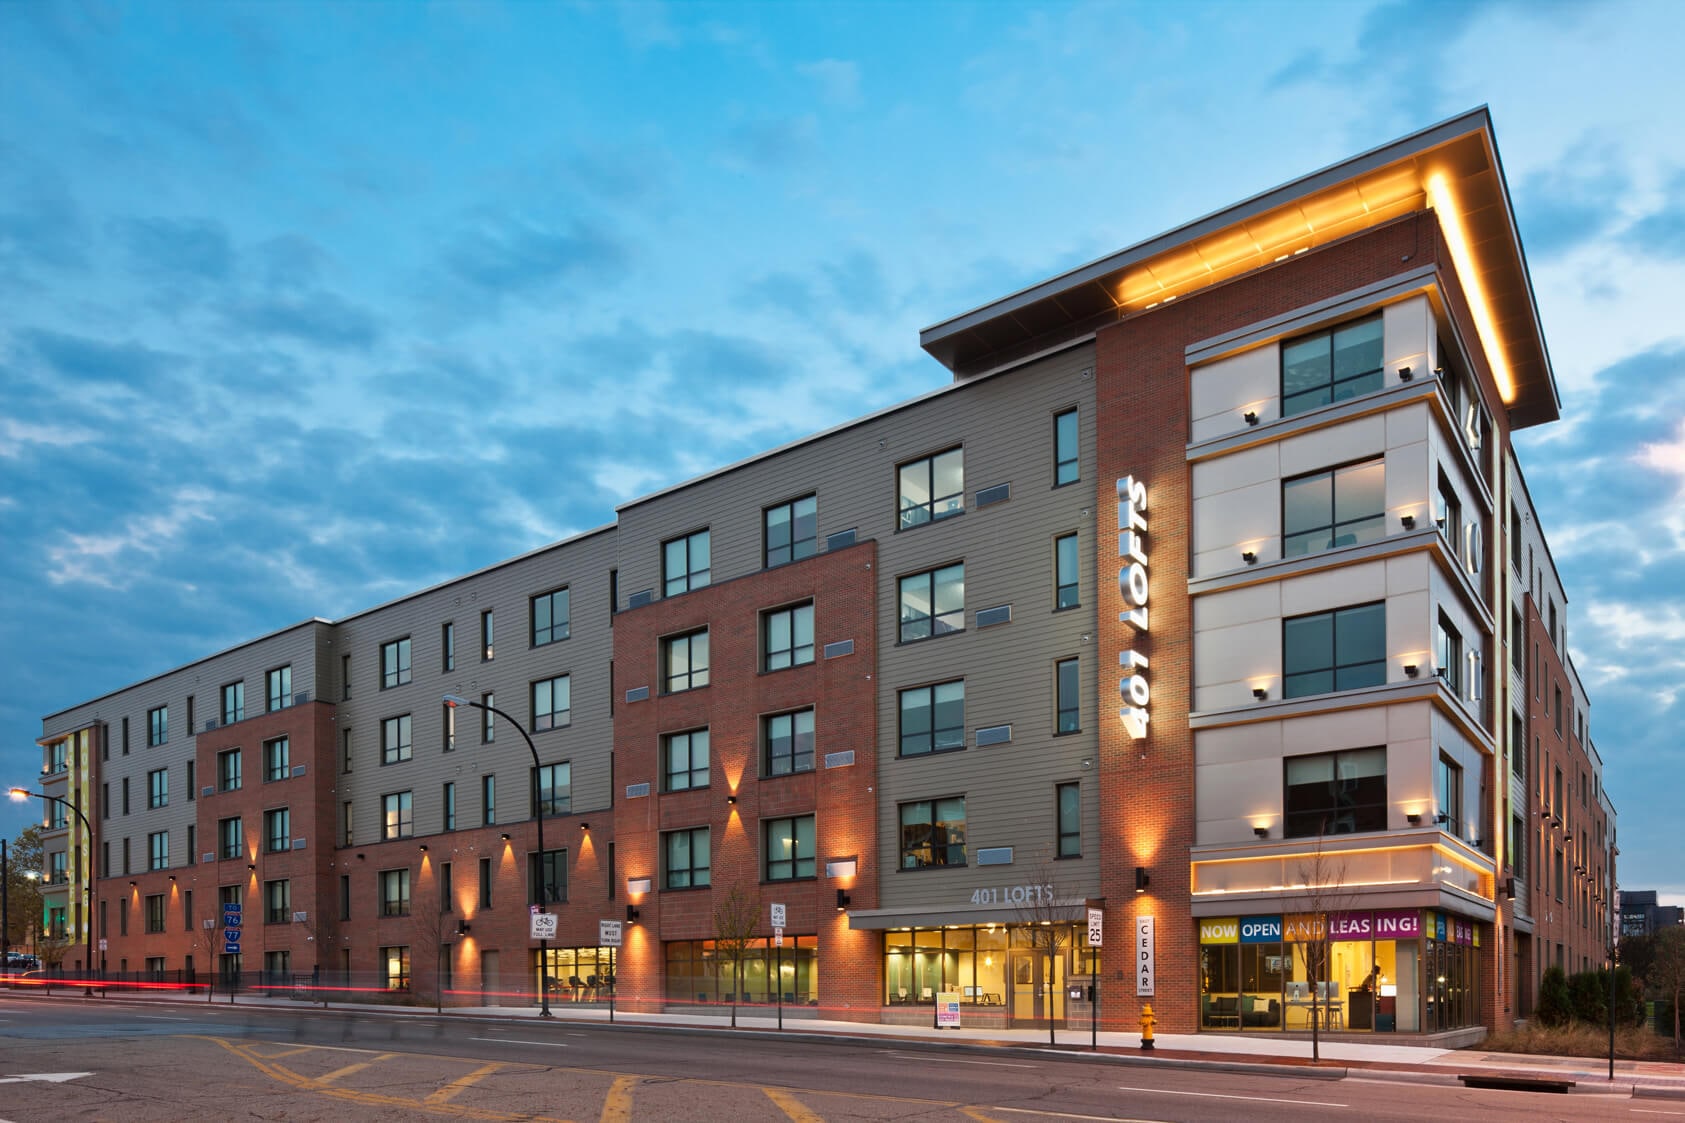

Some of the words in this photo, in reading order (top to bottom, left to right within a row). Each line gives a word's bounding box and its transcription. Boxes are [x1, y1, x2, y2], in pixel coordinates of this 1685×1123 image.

[1117, 474, 1148, 631] LOFTS
[1119, 650, 1149, 739] 401
[971, 888, 997, 905] 401
[1004, 885, 1053, 904] LOFTS
[227, 916, 239, 924] 76
[1090, 912, 1101, 920] SPEED
[1090, 928, 1101, 942] 25
[1201, 924, 1238, 938] NOW
[1242, 923, 1280, 937] OPEN
[1286, 921, 1324, 935] AND
[1330, 917, 1418, 934] LEASING!
[1141, 925, 1149, 986] CEDAR
